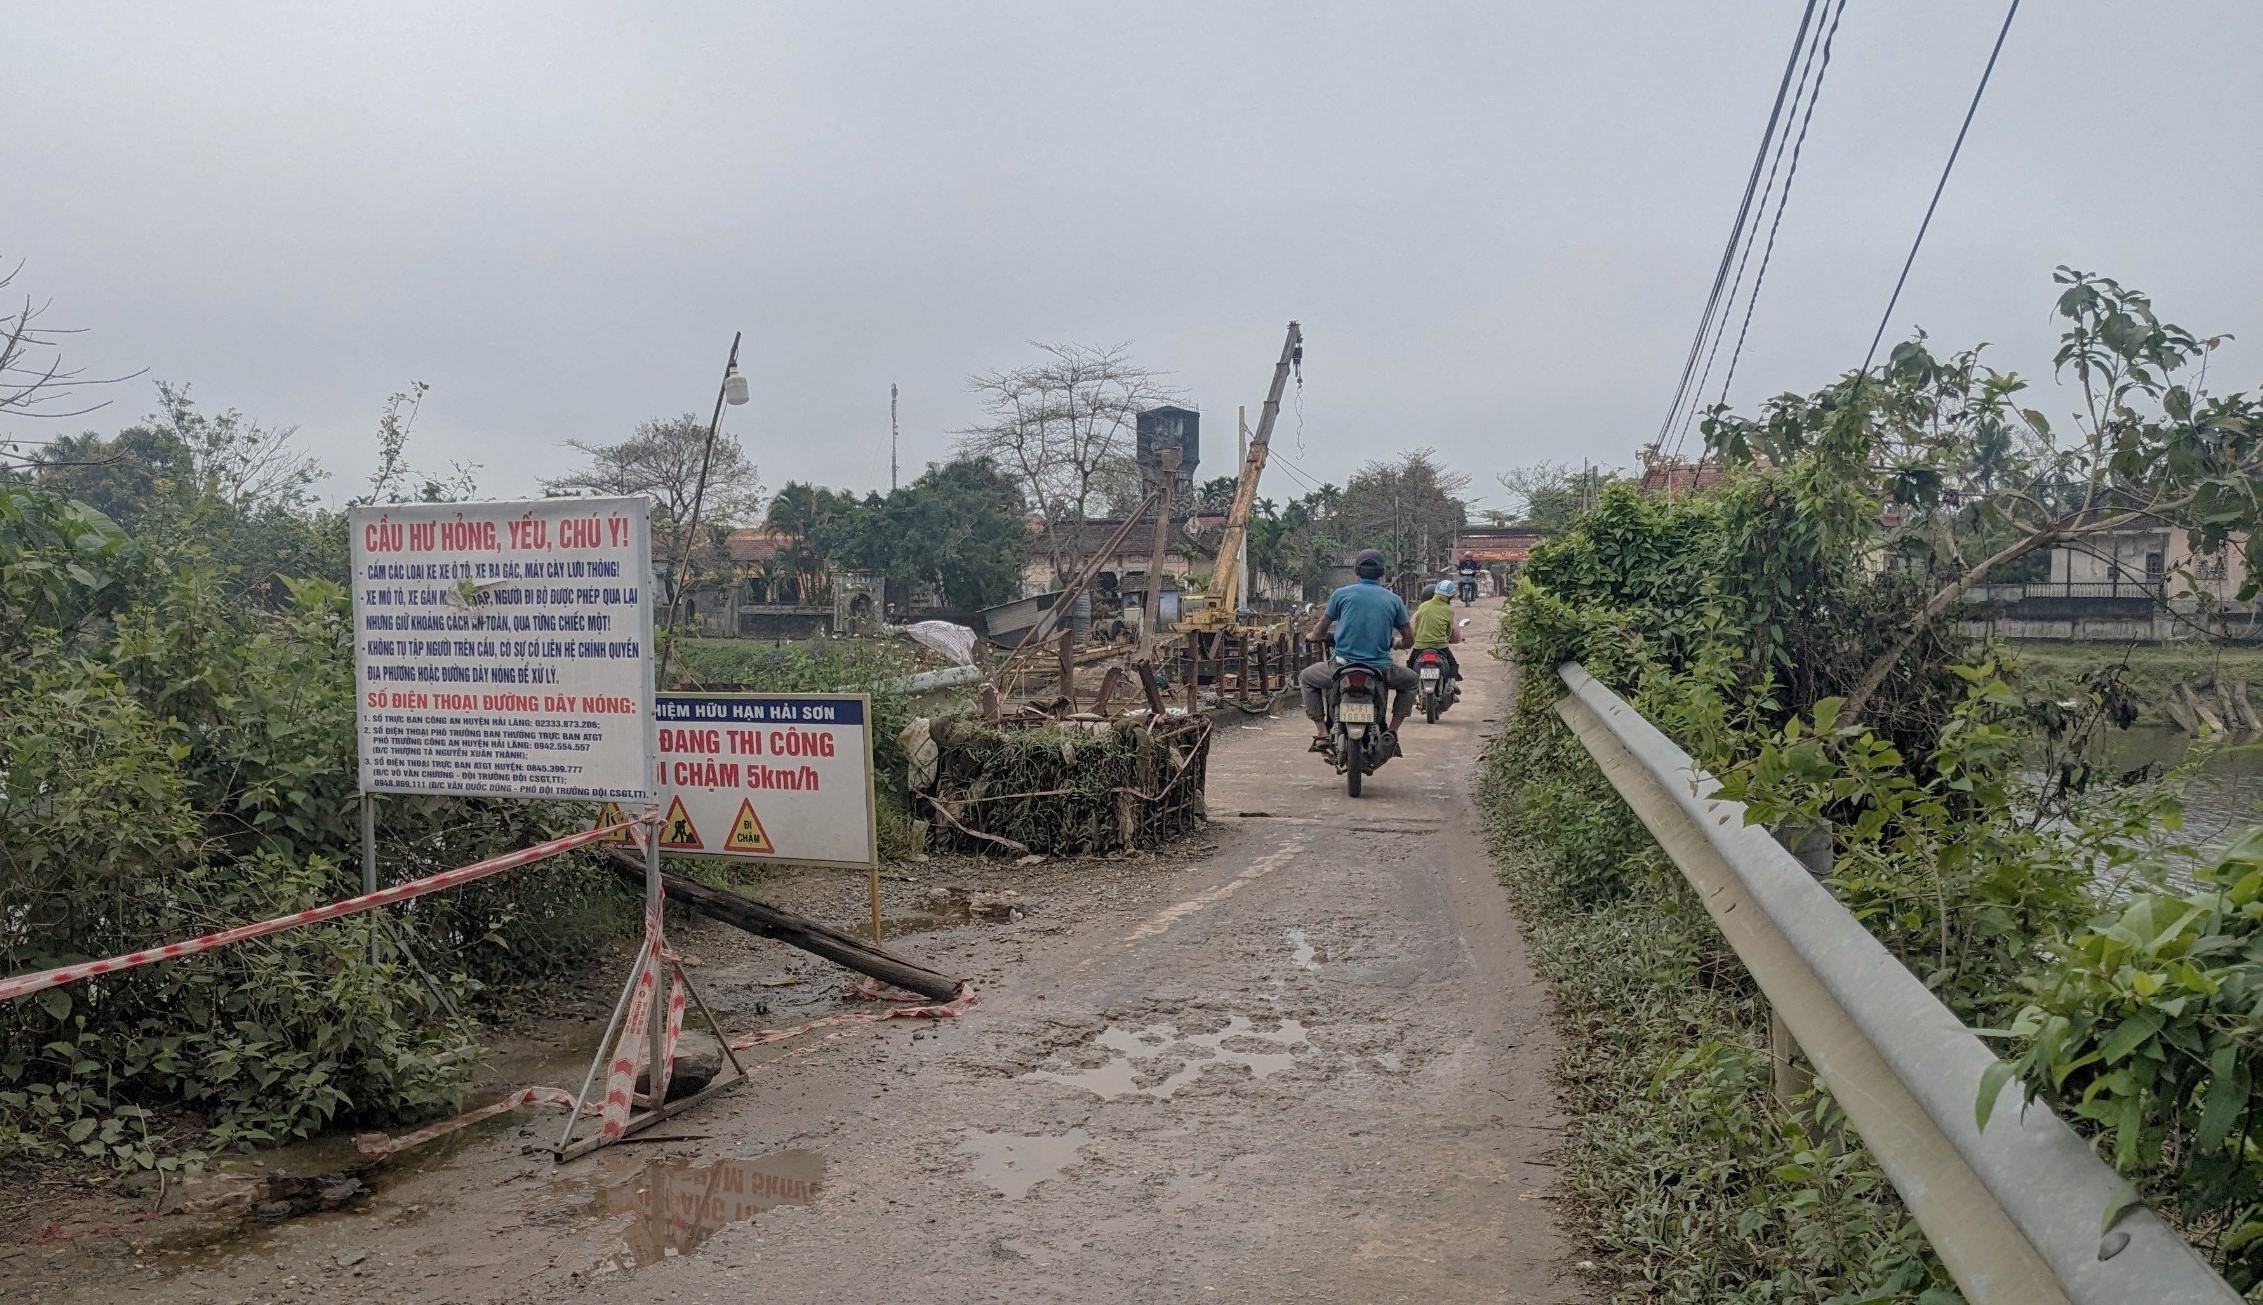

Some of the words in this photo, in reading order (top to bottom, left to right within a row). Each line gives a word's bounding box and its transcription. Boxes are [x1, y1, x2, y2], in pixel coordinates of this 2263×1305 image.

[364, 513, 403, 552] CẦU
[408, 519, 437, 551] HƯ
[440, 511, 501, 554] HỎNG,
[507, 510, 552, 553] YẾU,
[558, 508, 601, 548] CHÚ
[607, 511, 628, 547] Ý!
[367, 561, 386, 579] CẤM
[387, 561, 404, 579] CÁC
[406, 564, 424, 582] LOẠI
[426, 564, 437, 579] XE
[439, 564, 449, 579] XE
[451, 561, 458, 579] Ô
[459, 560, 472, 582] TÔ,
[474, 563, 486, 578] XE
[488, 563, 500, 578] BA
[502, 559, 522, 582] GÁC,
[524, 559, 544, 578] MÁY
[546, 559, 564, 578] CÀY
[566, 560, 584, 577] LƯU
[586, 558, 619, 577] THÔNG!
[365, 590, 376, 605] XE
[378, 586, 391, 605] MÔ
[393, 586, 405, 606] TÔ,
[407, 589, 418, 605] XE
[420, 586, 437, 605] GẮN
[493, 585, 522, 605] NGƯỜI
[524, 589, 534, 604] ĐI
[535, 585, 548, 608] BỘ
[549, 587, 574, 607] ĐƯỢC
[576, 585, 600, 604] PHÉP
[602, 588, 621, 605] QUA
[623, 587, 637, 607] LẠI
[410, 611, 445, 630] KHOẢNG
[446, 612, 469, 630] CÁCH
[513, 615, 530, 632] QUA
[532, 612, 556, 631] TỪNG
[558, 610, 585, 631] CHIẾC
[587, 611, 611, 634] MỘT!
[367, 637, 394, 655] KHÔNG
[396, 640, 407, 659] TỤ
[408, 638, 424, 659] TẬP
[425, 637, 451, 656] NGƯỜI
[453, 638, 475, 656] TRÊN
[499, 638, 511, 657] CÓ
[513, 640, 527, 660] SỰ
[527, 636, 540, 657] CỐ
[541, 638, 562, 657] LIÊN
[563, 638, 576, 661] HỆ
[577, 638, 606, 657] CHÍNH
[367, 665, 381, 683] ĐỊA
[382, 664, 415, 681] PHƯƠNG
[417, 664, 440, 685] HOẶC
[441, 663, 470, 682] ĐƯỜNG
[472, 664, 489, 682] DÂY
[490, 664, 515, 683] NÓNG
[531, 662, 544, 683] XỬ
[545, 665, 559, 683] LÝ.
[367, 687, 387, 708] SỐ
[391, 690, 427, 712] ĐIỆN
[432, 693, 478, 713] THOẠI
[482, 691, 539, 711] ĐƯỜNG
[543, 692, 576, 712] DÂY
[582, 693, 635, 713] NÓNG:
[372, 713, 382, 722] SỐ
[696, 703, 727, 718] HỮU
[733, 705, 764, 721] HẠN
[770, 703, 797, 719] HẢI
[802, 705, 835, 720] SƠN
[372, 725, 383, 734] SỐ
[430, 727, 447, 738] PHÓ
[483, 730, 500, 740] BAN
[562, 732, 580, 740] BAN
[582, 733, 602, 741] ATGT
[373, 735, 389, 744] PHÓ
[448, 739, 460, 749] AN
[659, 728, 720, 754] ĐANG
[727, 730, 762, 755] THI
[770, 726, 835, 757] CÔNG
[364, 757, 371, 765] 3.
[373, 756, 384, 765] SỐ
[674, 757, 740, 792] CHẬM
[747, 764, 819, 790] 5km/h
[519, 784, 536, 793] PHÓ
[744, 820, 752, 830] ĐI
[737, 832, 760, 845] CHẬM
